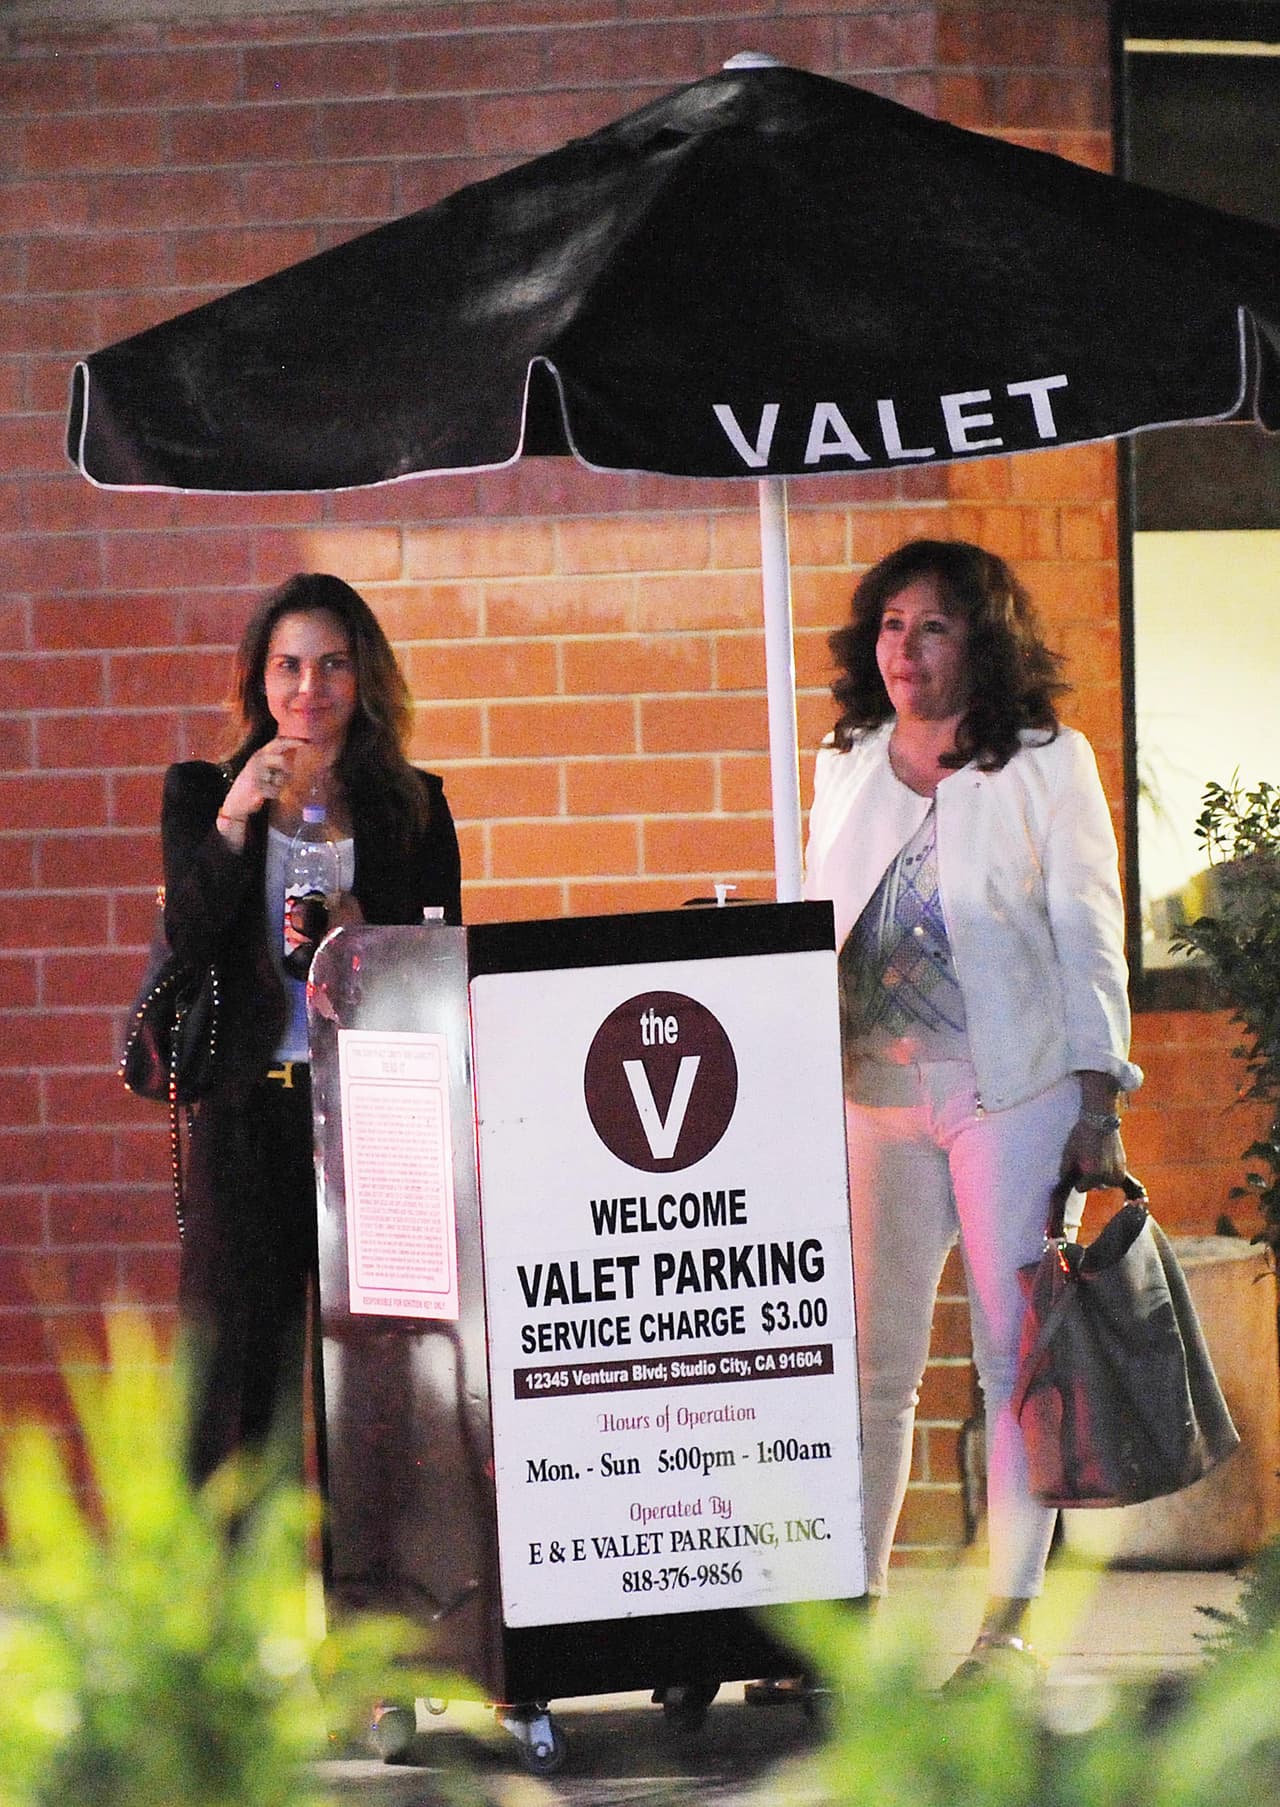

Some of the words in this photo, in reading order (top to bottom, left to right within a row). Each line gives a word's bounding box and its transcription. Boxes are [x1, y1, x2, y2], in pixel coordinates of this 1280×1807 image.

[712, 374, 1069, 468] VALET
[640, 1008, 679, 1046] the
[622, 1055, 701, 1159] V
[591, 1189, 748, 1235] WELCOME
[517, 1255, 640, 1308] VALET
[655, 1238, 825, 1296] PARKING
[521, 1316, 631, 1354] SERVICE
[640, 1306, 746, 1342] CHARGE
[762, 1297, 828, 1335] $3.00
[526, 1374, 569, 1389] 12345
[572, 1370, 628, 1386] Ventura
[671, 1361, 716, 1379] Studio
[720, 1358, 751, 1376] City,
[755, 1355, 775, 1371] CA
[779, 1351, 823, 1368] 91604
[599, 1412, 650, 1432] Hours
[656, 1404, 671, 1432] of
[677, 1406, 756, 1429] Operation
[526, 1459, 581, 1483] Mon.
[601, 1453, 640, 1477] Sun
[658, 1446, 736, 1476] 5:00pm
[758, 1439, 832, 1464] 1:00am
[630, 1499, 702, 1525] Operated
[709, 1496, 732, 1520] By
[529, 1542, 544, 1565] E
[549, 1541, 566, 1562] &
[572, 1538, 587, 1561] E
[592, 1532, 663, 1559] VALET
[671, 1522, 780, 1553] PARKING,
[786, 1518, 832, 1542] INC.
[622, 1562, 742, 1592] 818-376-9856
